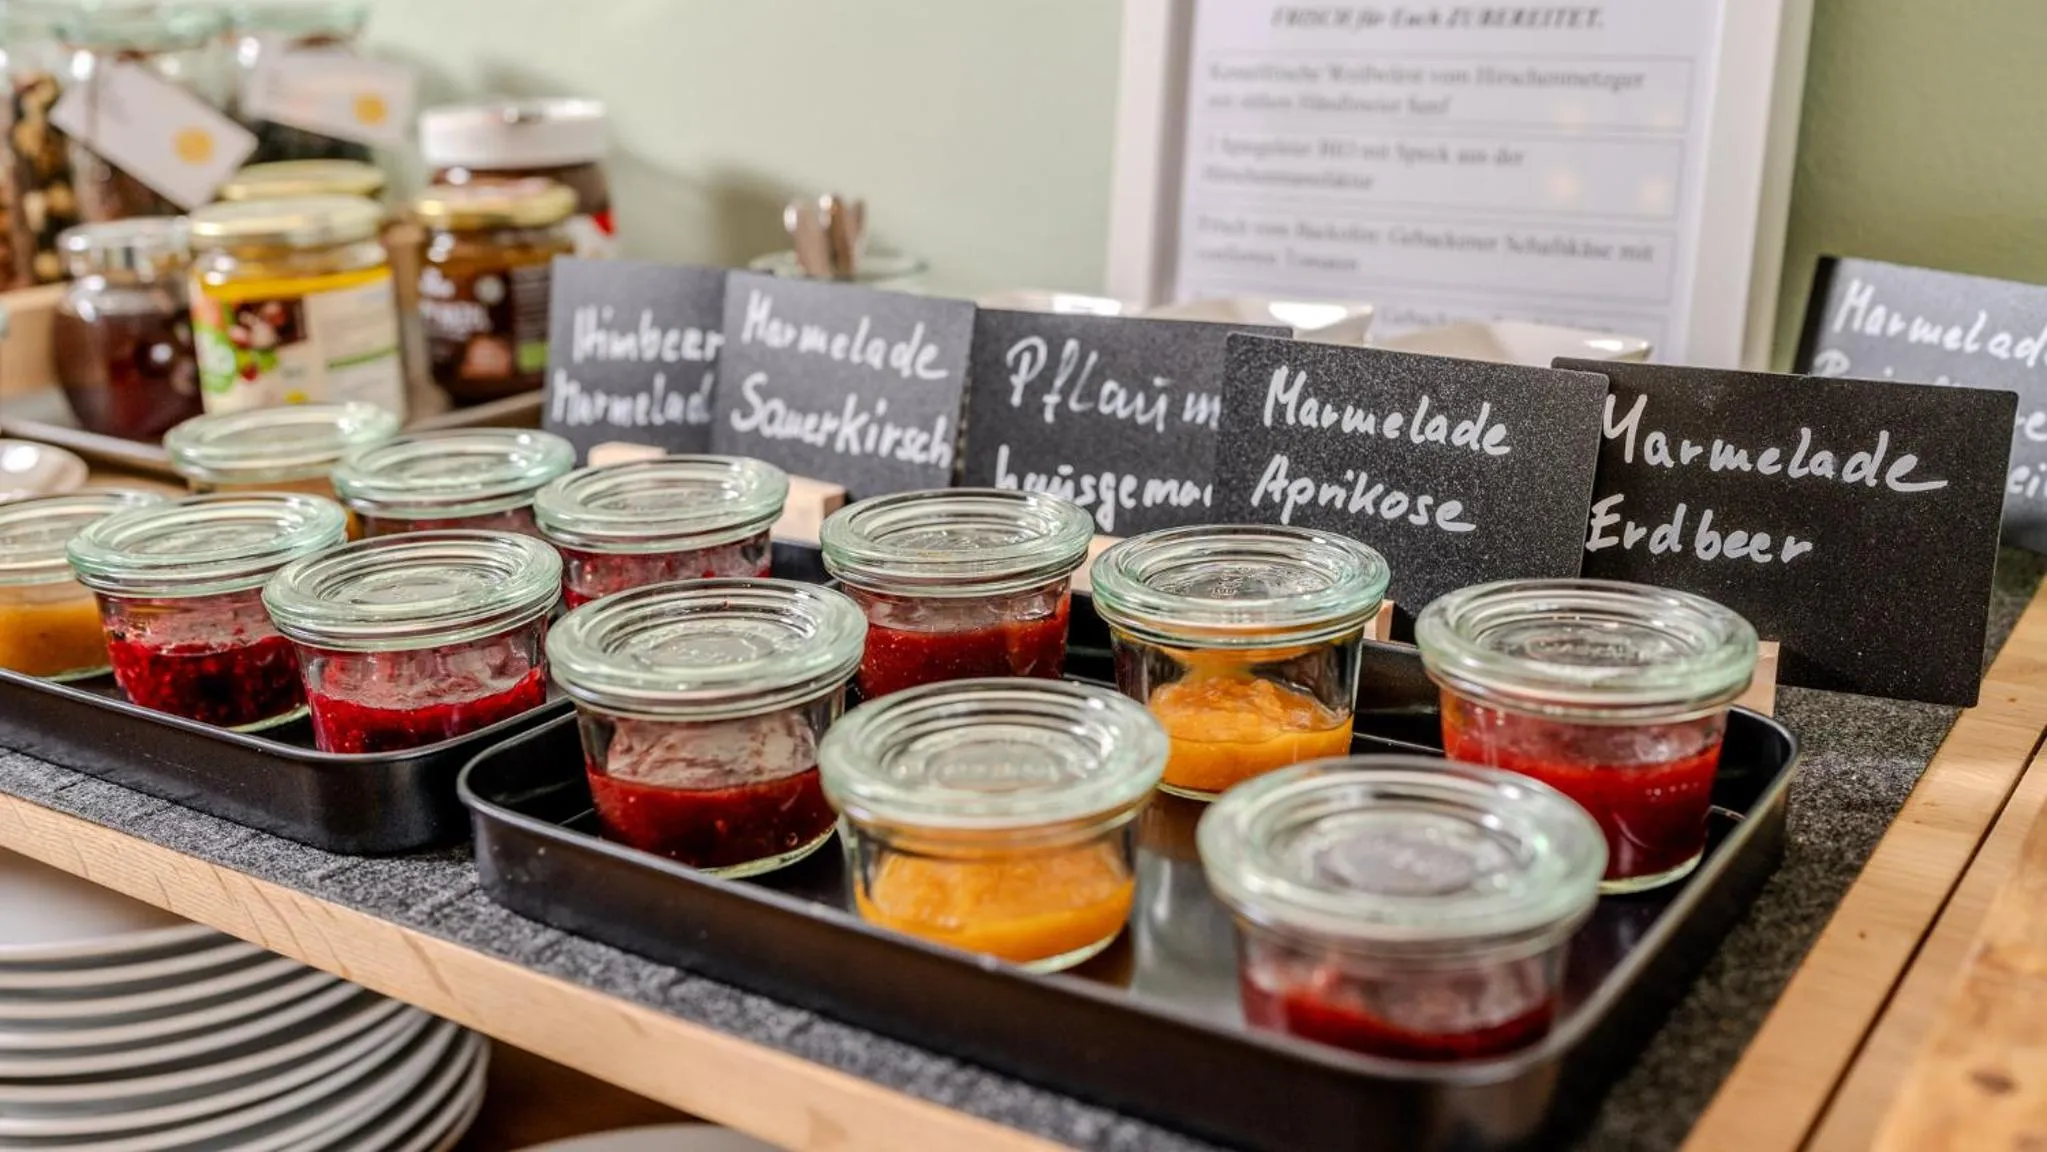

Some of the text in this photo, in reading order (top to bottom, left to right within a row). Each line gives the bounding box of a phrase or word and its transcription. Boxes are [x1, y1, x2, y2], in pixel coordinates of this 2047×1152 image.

[572, 304, 726, 364] Himbeer
[741, 288, 949, 380] Marmelade
[1833, 279, 2047, 368] Marmelad
[730, 372, 952, 469] Sauerkirsch
[1262, 366, 1511, 456] Marmelade
[1602, 394, 1949, 492] Marmelade
[1250, 453, 1477, 531] Aprikose
[1585, 493, 1814, 565] Erdbeer
